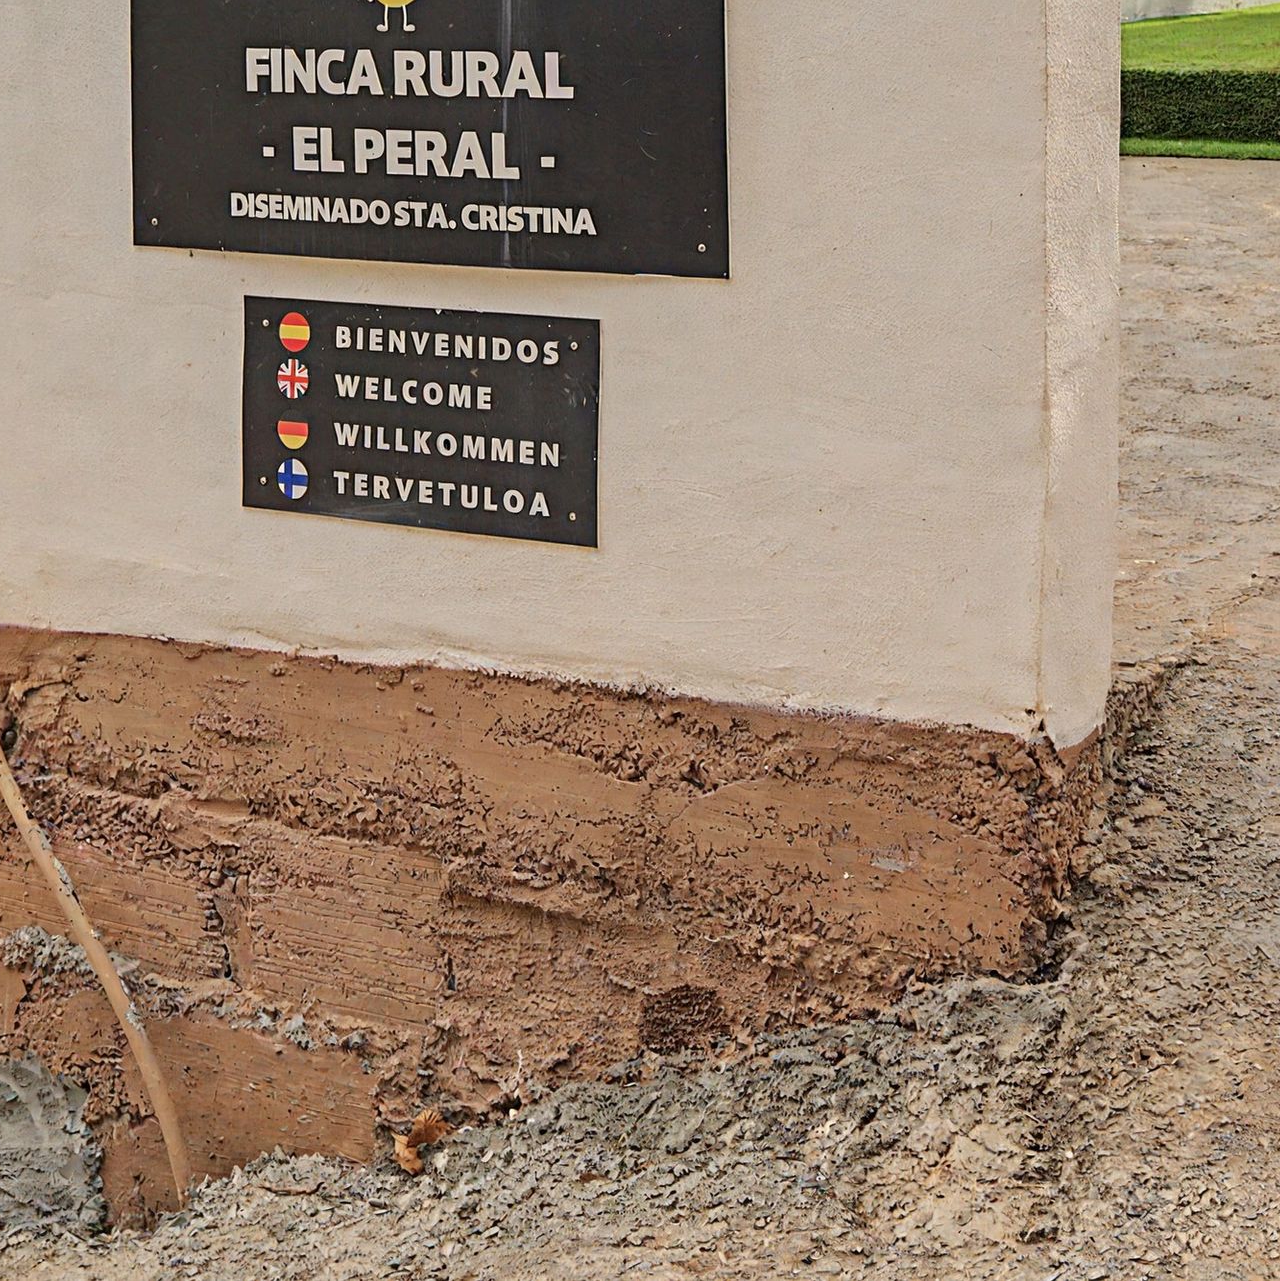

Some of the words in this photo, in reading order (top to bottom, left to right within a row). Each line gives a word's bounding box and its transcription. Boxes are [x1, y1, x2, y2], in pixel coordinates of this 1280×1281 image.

[244, 47, 385, 96] FINCA
[393, 50, 575, 99] RURAL
[292, 126, 346, 173] EL
[353, 128, 521, 179] PERAL
[230, 191, 391, 226] DISEMINADO
[394, 201, 458, 230] STA.
[461, 203, 598, 236] CRISTINA
[335, 325, 561, 366] BIENVENIDOS
[334, 373, 493, 411] WELCOME
[333, 422, 561, 467] WILLKOMMEN
[332, 470, 551, 518] TERVETULOA
